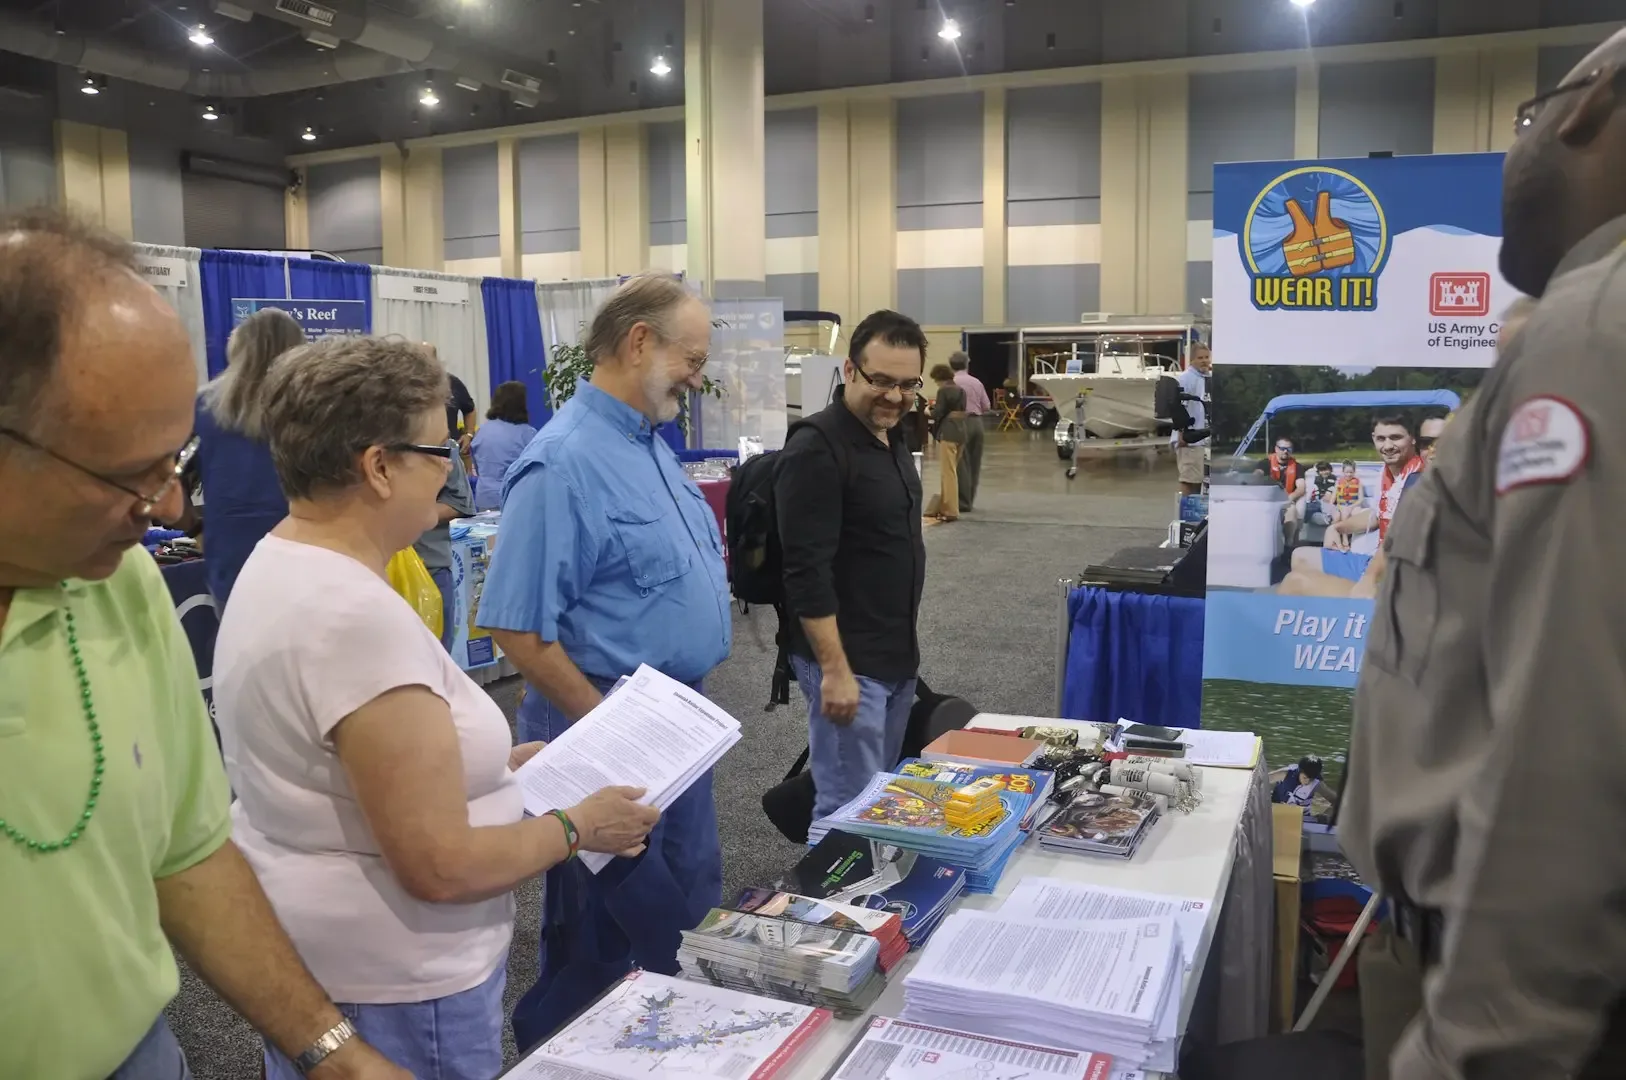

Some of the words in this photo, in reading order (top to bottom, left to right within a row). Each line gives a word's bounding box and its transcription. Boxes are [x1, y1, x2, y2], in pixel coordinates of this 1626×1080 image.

[1255, 277, 1333, 306] WEAR
[1339, 277, 1373, 306] IT!
[307, 308, 338, 320] Reef
[1428, 322, 1447, 334] US
[1450, 323, 1485, 337] Army
[1427, 336, 1441, 347] of
[1273, 609, 1338, 642] Play
[1343, 612, 1367, 639] it
[1294, 644, 1361, 673] WEA
